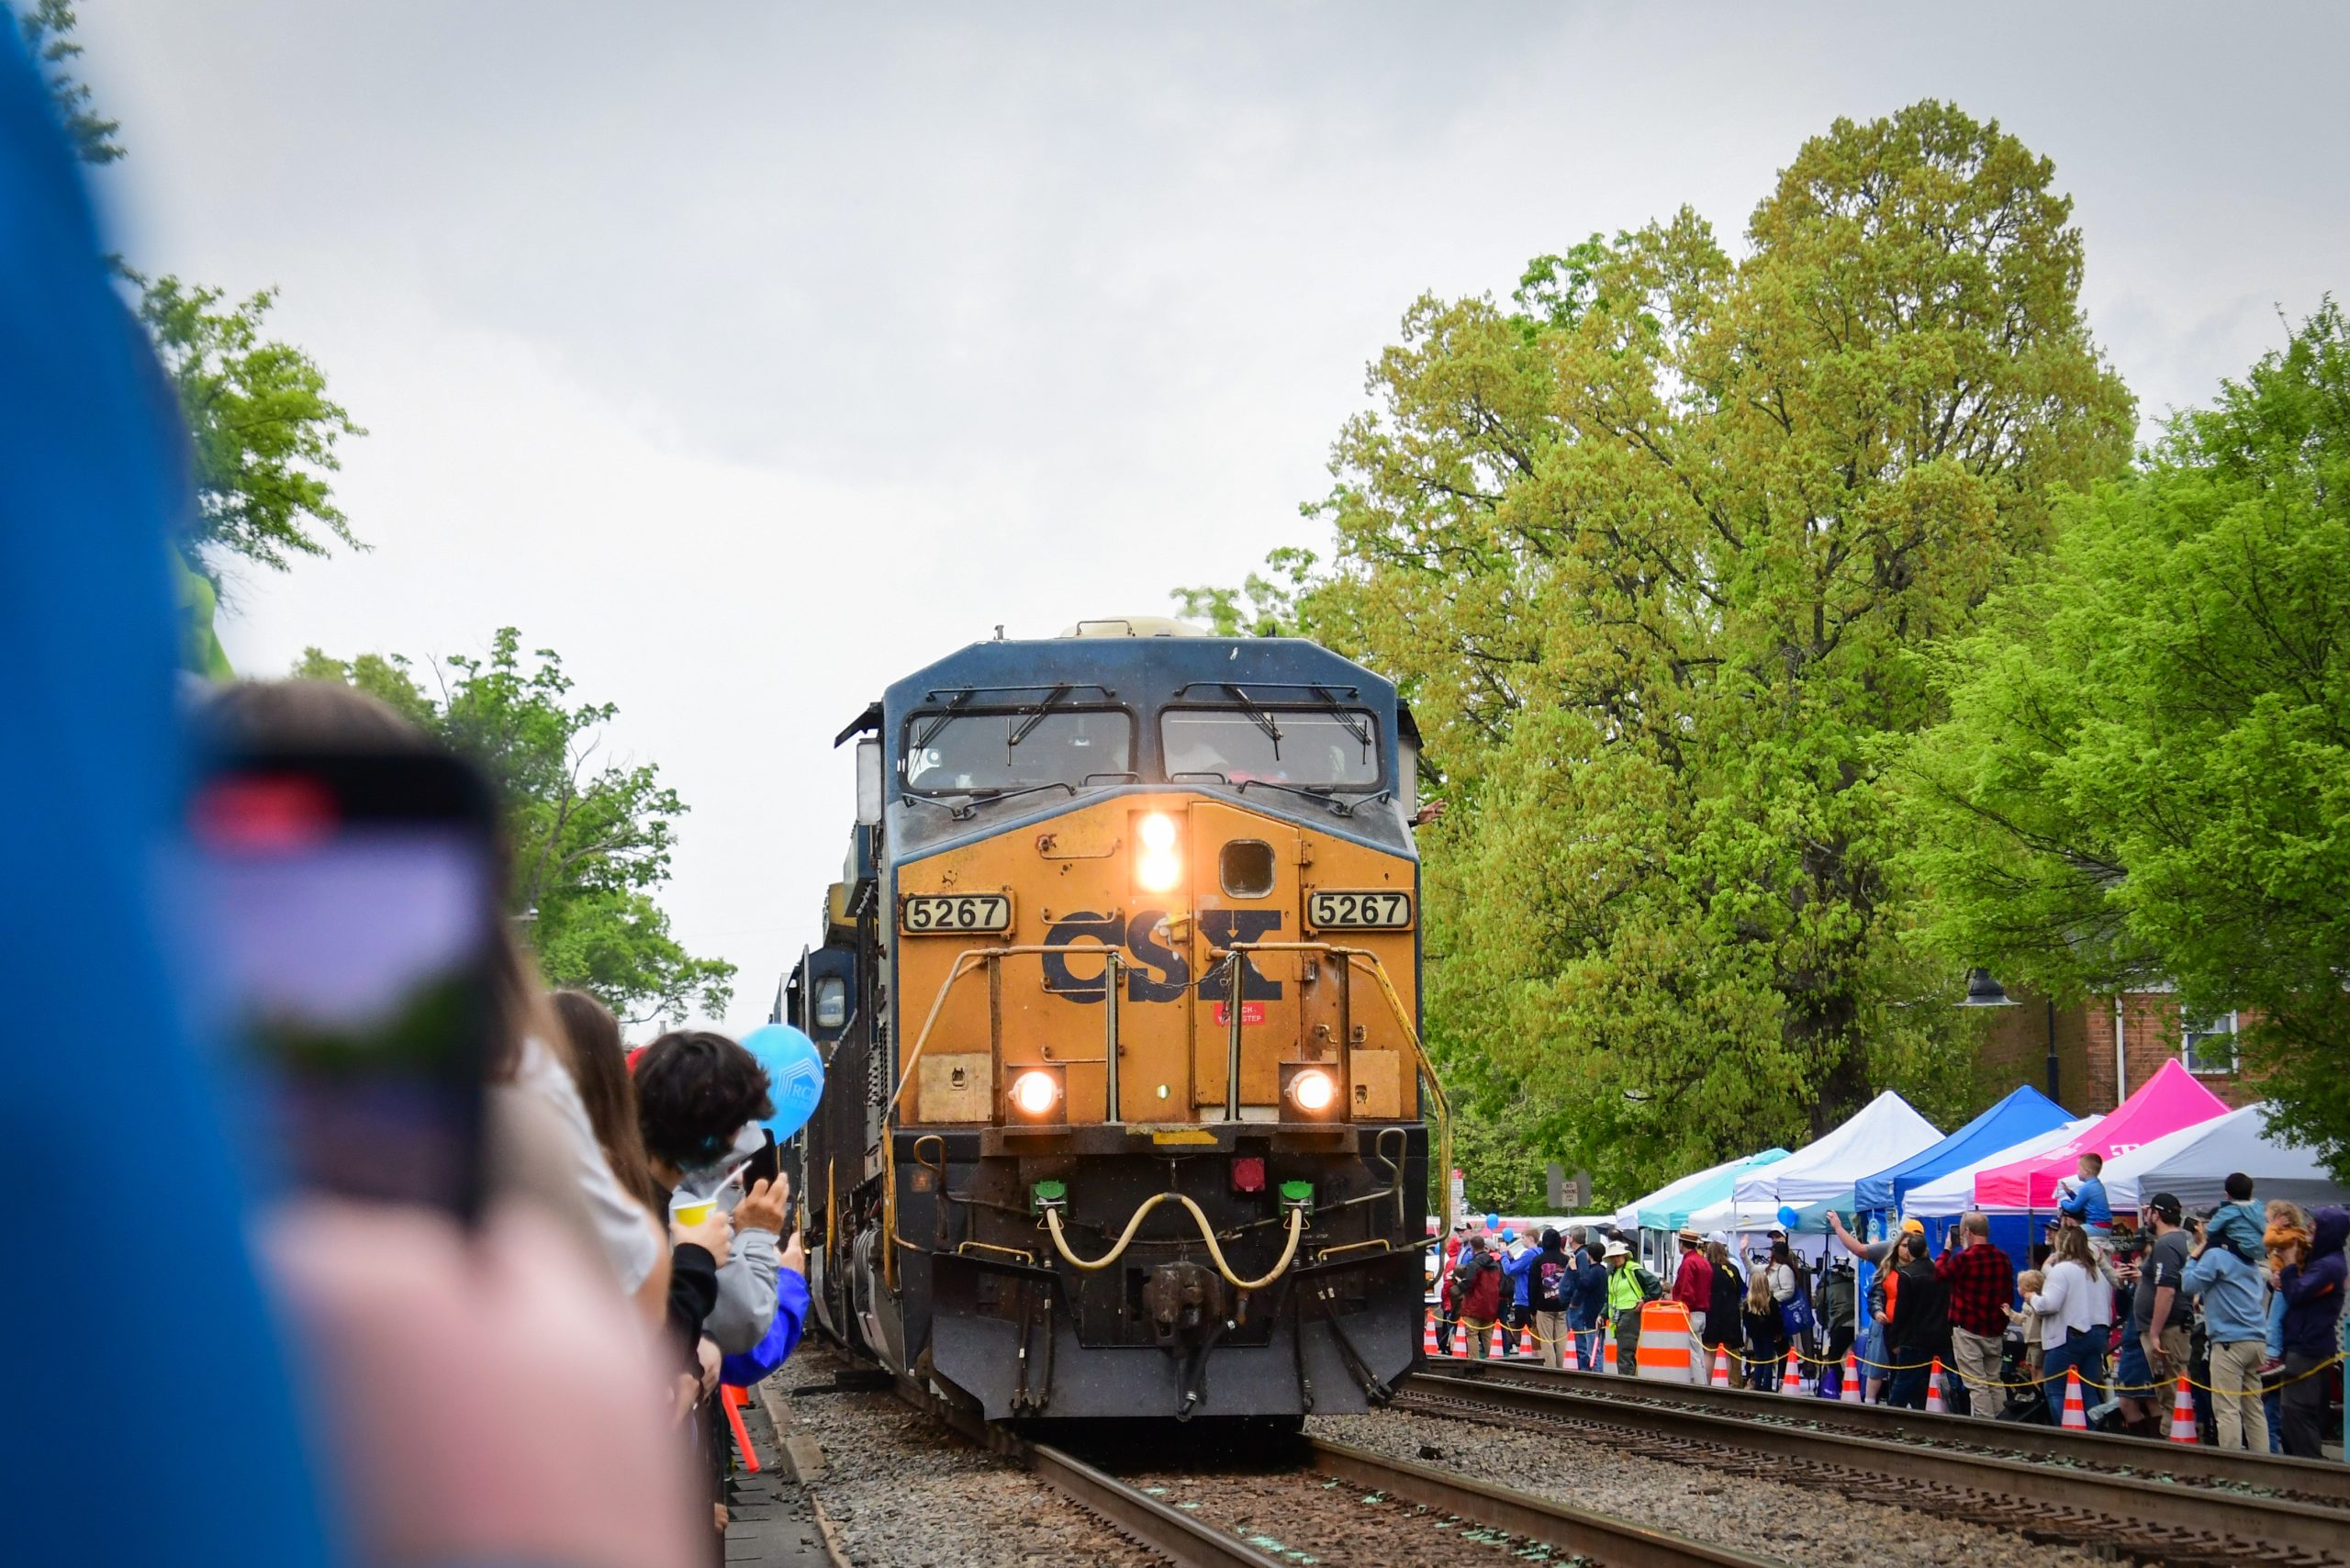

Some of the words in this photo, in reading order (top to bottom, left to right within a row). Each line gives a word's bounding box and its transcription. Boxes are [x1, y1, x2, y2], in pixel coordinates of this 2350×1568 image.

[912, 899, 1000, 927] 5267
[1318, 896, 1401, 924] 5267
[1042, 910, 1282, 1003] CSX
